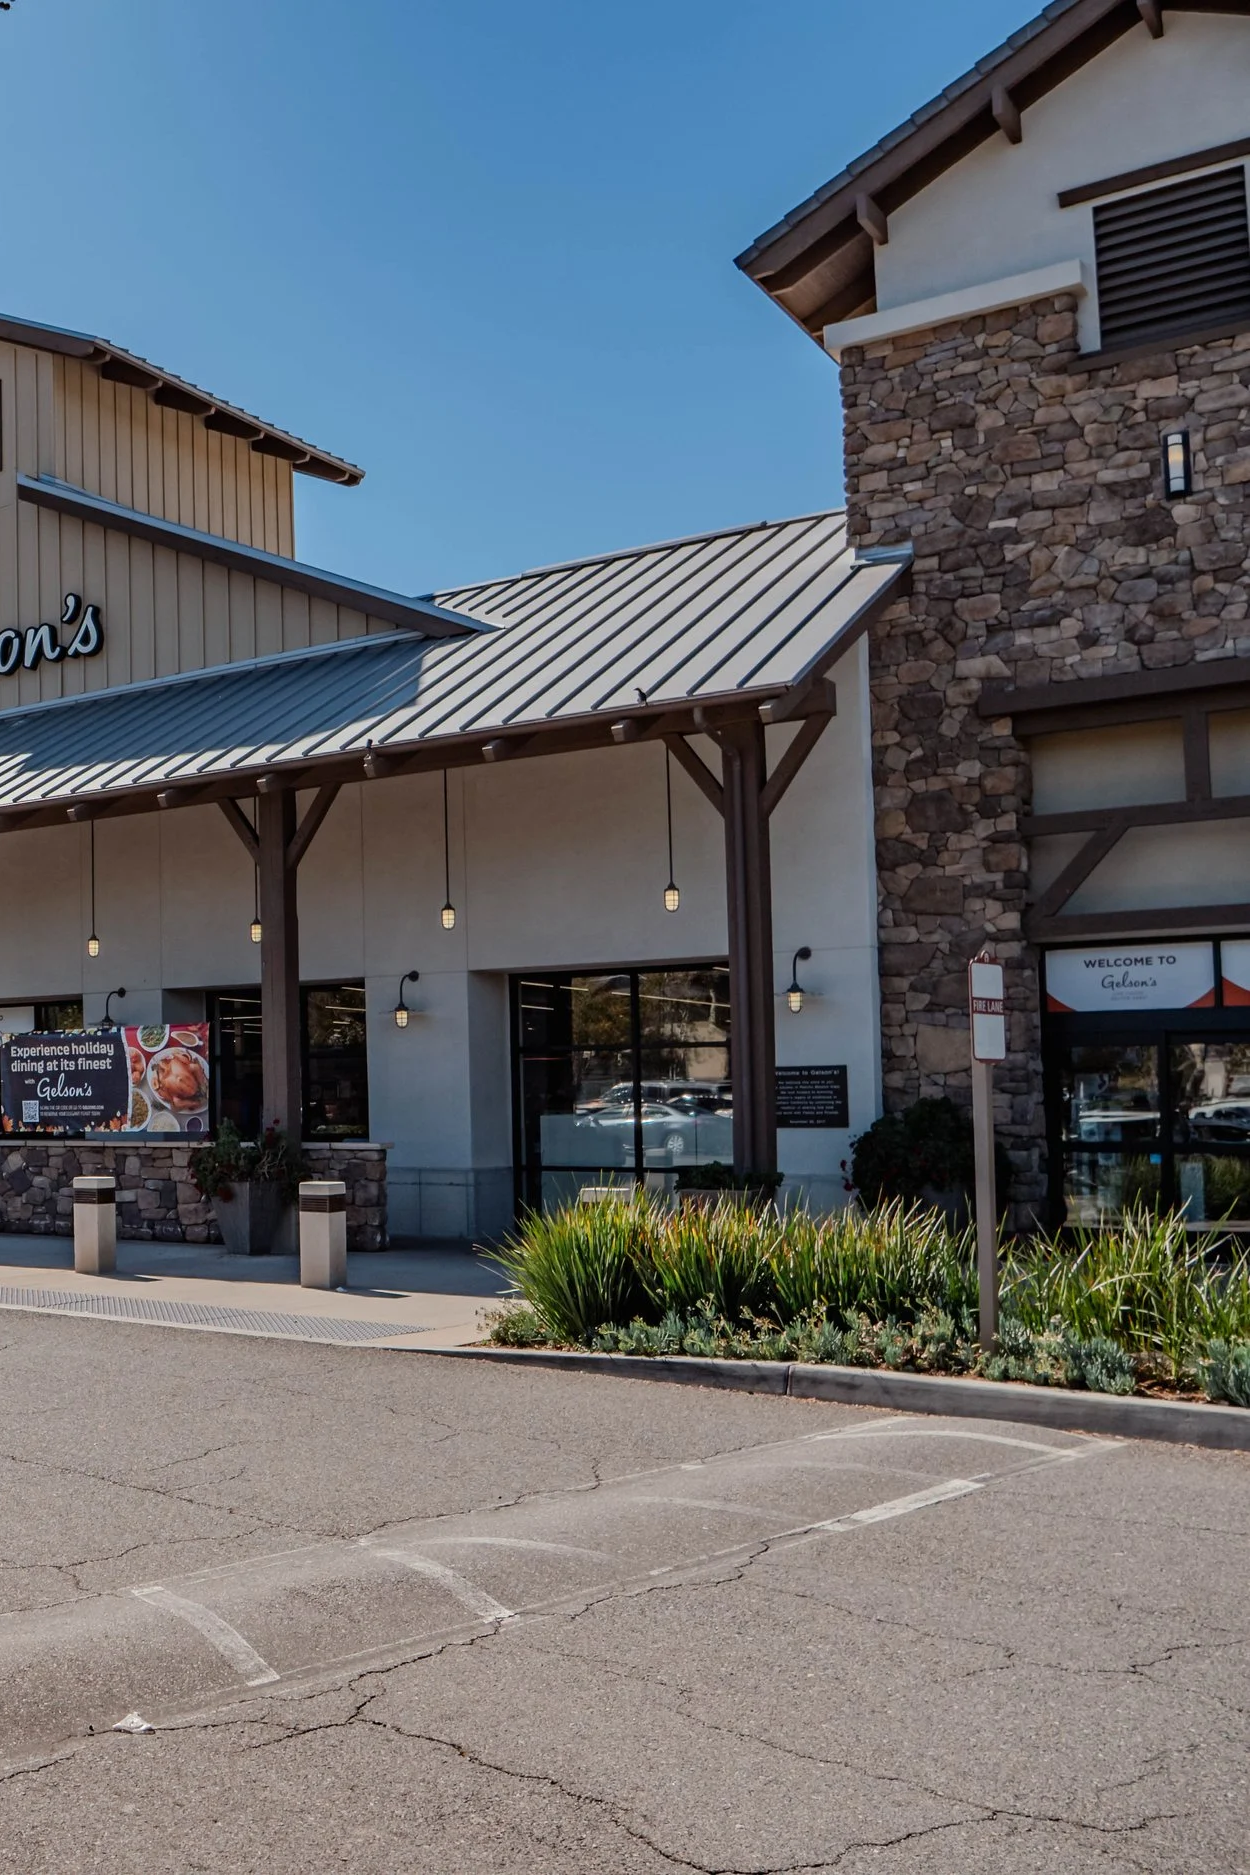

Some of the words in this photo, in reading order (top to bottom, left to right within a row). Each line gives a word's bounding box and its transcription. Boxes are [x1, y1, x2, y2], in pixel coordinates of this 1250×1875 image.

[1083, 957, 1153, 968] WELCOME
[1158, 956, 1176, 965] TO
[1101, 971, 1157, 991] Gelson's
[973, 1000, 986, 1012] FIRE
[987, 1001, 1004, 1013] LANE
[11, 1044, 70, 1058] Experience
[71, 1041, 114, 1056] holiday
[11, 1060, 44, 1074] dining
[46, 1060, 58, 1071] at
[60, 1059, 76, 1071] its
[77, 1057, 112, 1070] finest
[36, 1072, 92, 1101] Gelson's
